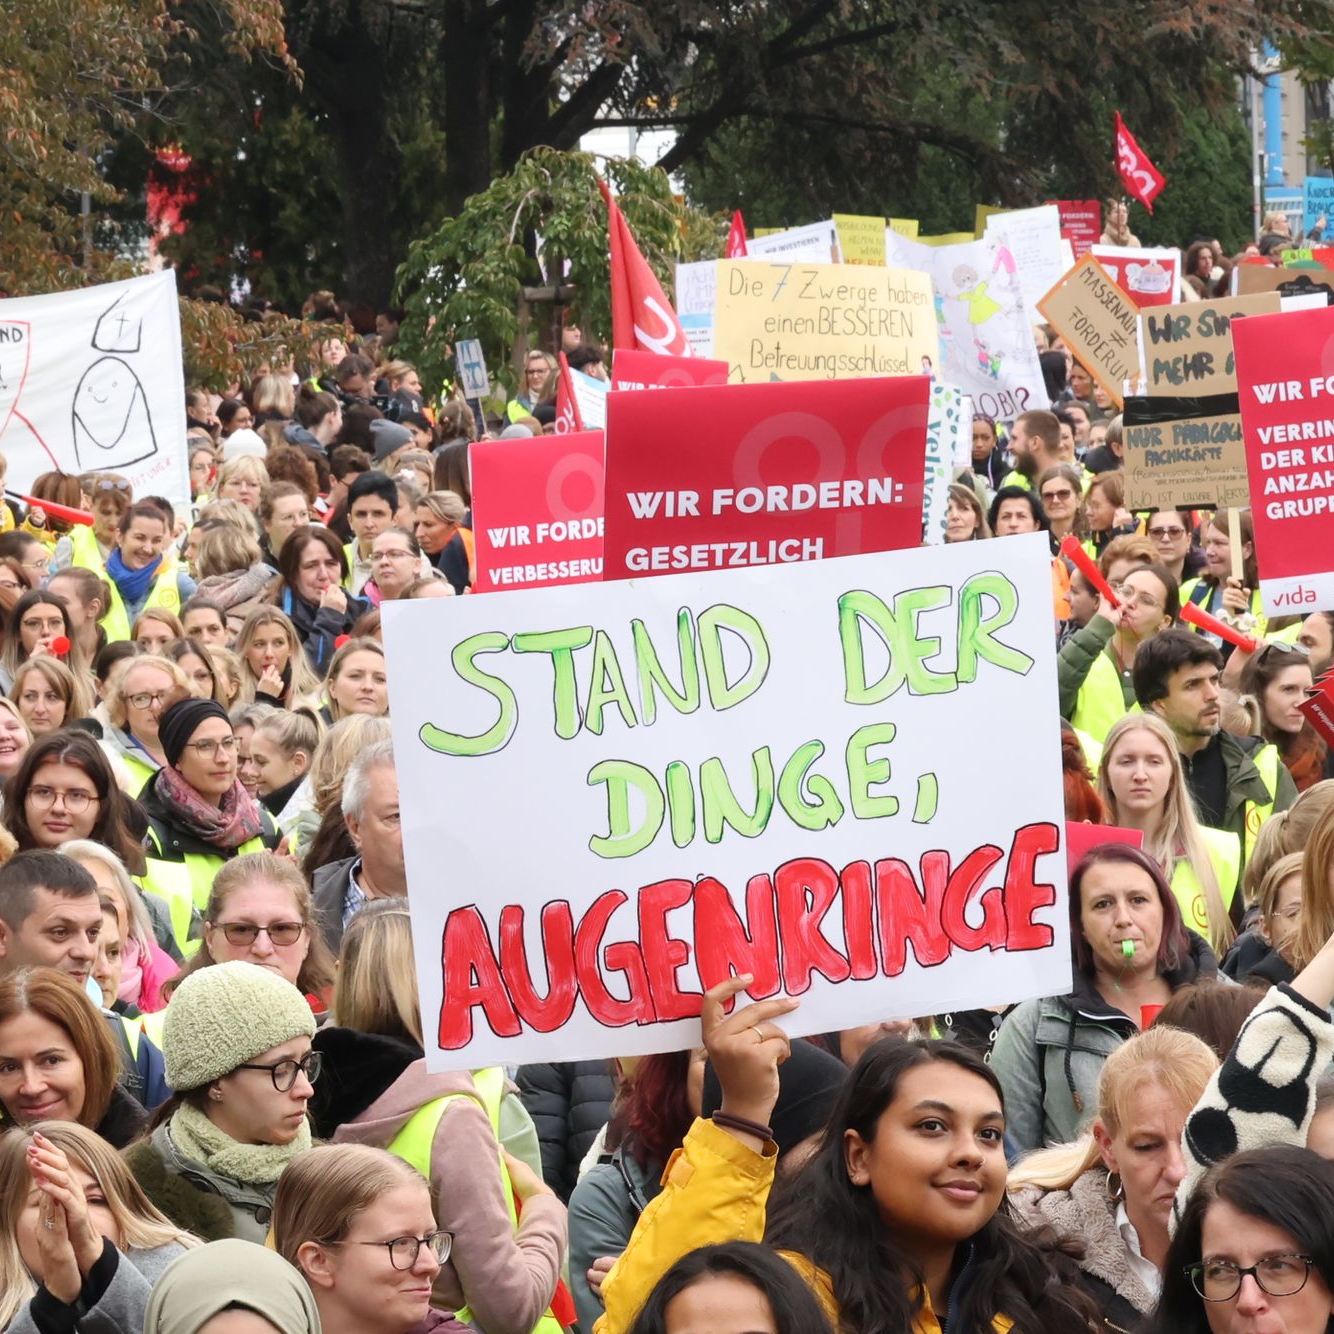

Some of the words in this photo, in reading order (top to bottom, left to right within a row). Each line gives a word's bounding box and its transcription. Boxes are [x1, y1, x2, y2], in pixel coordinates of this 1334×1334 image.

[729, 267, 764, 297] Die
[770, 263, 793, 302] 7
[798, 270, 877, 308] Zwerge
[888, 275, 928, 306] haben
[764, 312, 815, 335] einen
[818, 306, 913, 338] BESSEREN
[1148, 313, 1191, 344] WIR
[750, 337, 914, 380] Betreuungsschlüssel
[1153, 351, 1215, 386] MEHR
[1252, 380, 1304, 405] WIR
[1261, 448, 1307, 471] DER
[626, 489, 700, 520] WIR
[712, 476, 904, 515] FORDERN:
[487, 524, 531, 549] WIR
[625, 536, 825, 573] GESETZLICH
[1272, 584, 1317, 607] vida
[418, 603, 772, 757] STAND
[837, 569, 1036, 705] DER
[587, 722, 939, 859] DINGE,
[437, 821, 1060, 1050] AUGENRINGE
